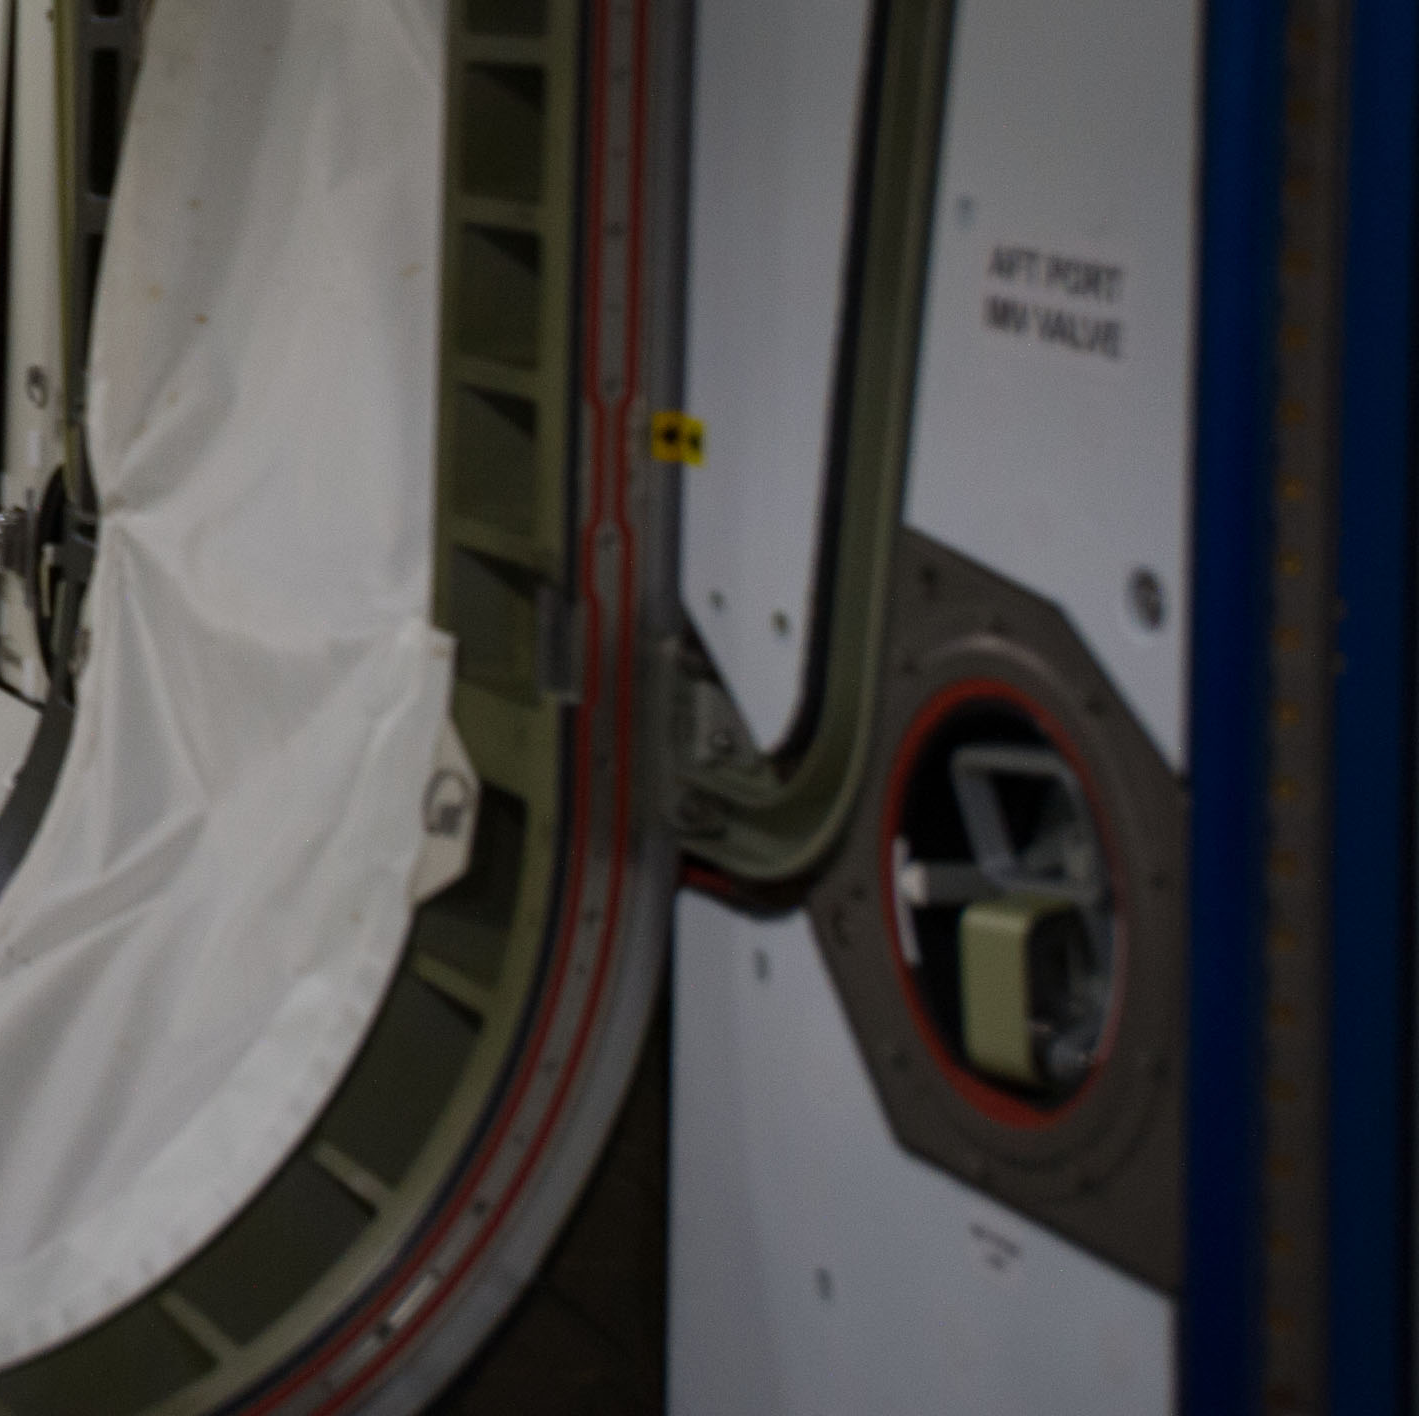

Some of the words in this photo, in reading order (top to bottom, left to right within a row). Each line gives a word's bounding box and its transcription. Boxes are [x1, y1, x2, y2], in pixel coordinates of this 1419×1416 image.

[990, 245, 1040, 284] AFT
[1045, 255, 1124, 303] PORT
[1034, 306, 1122, 362] VALVE
